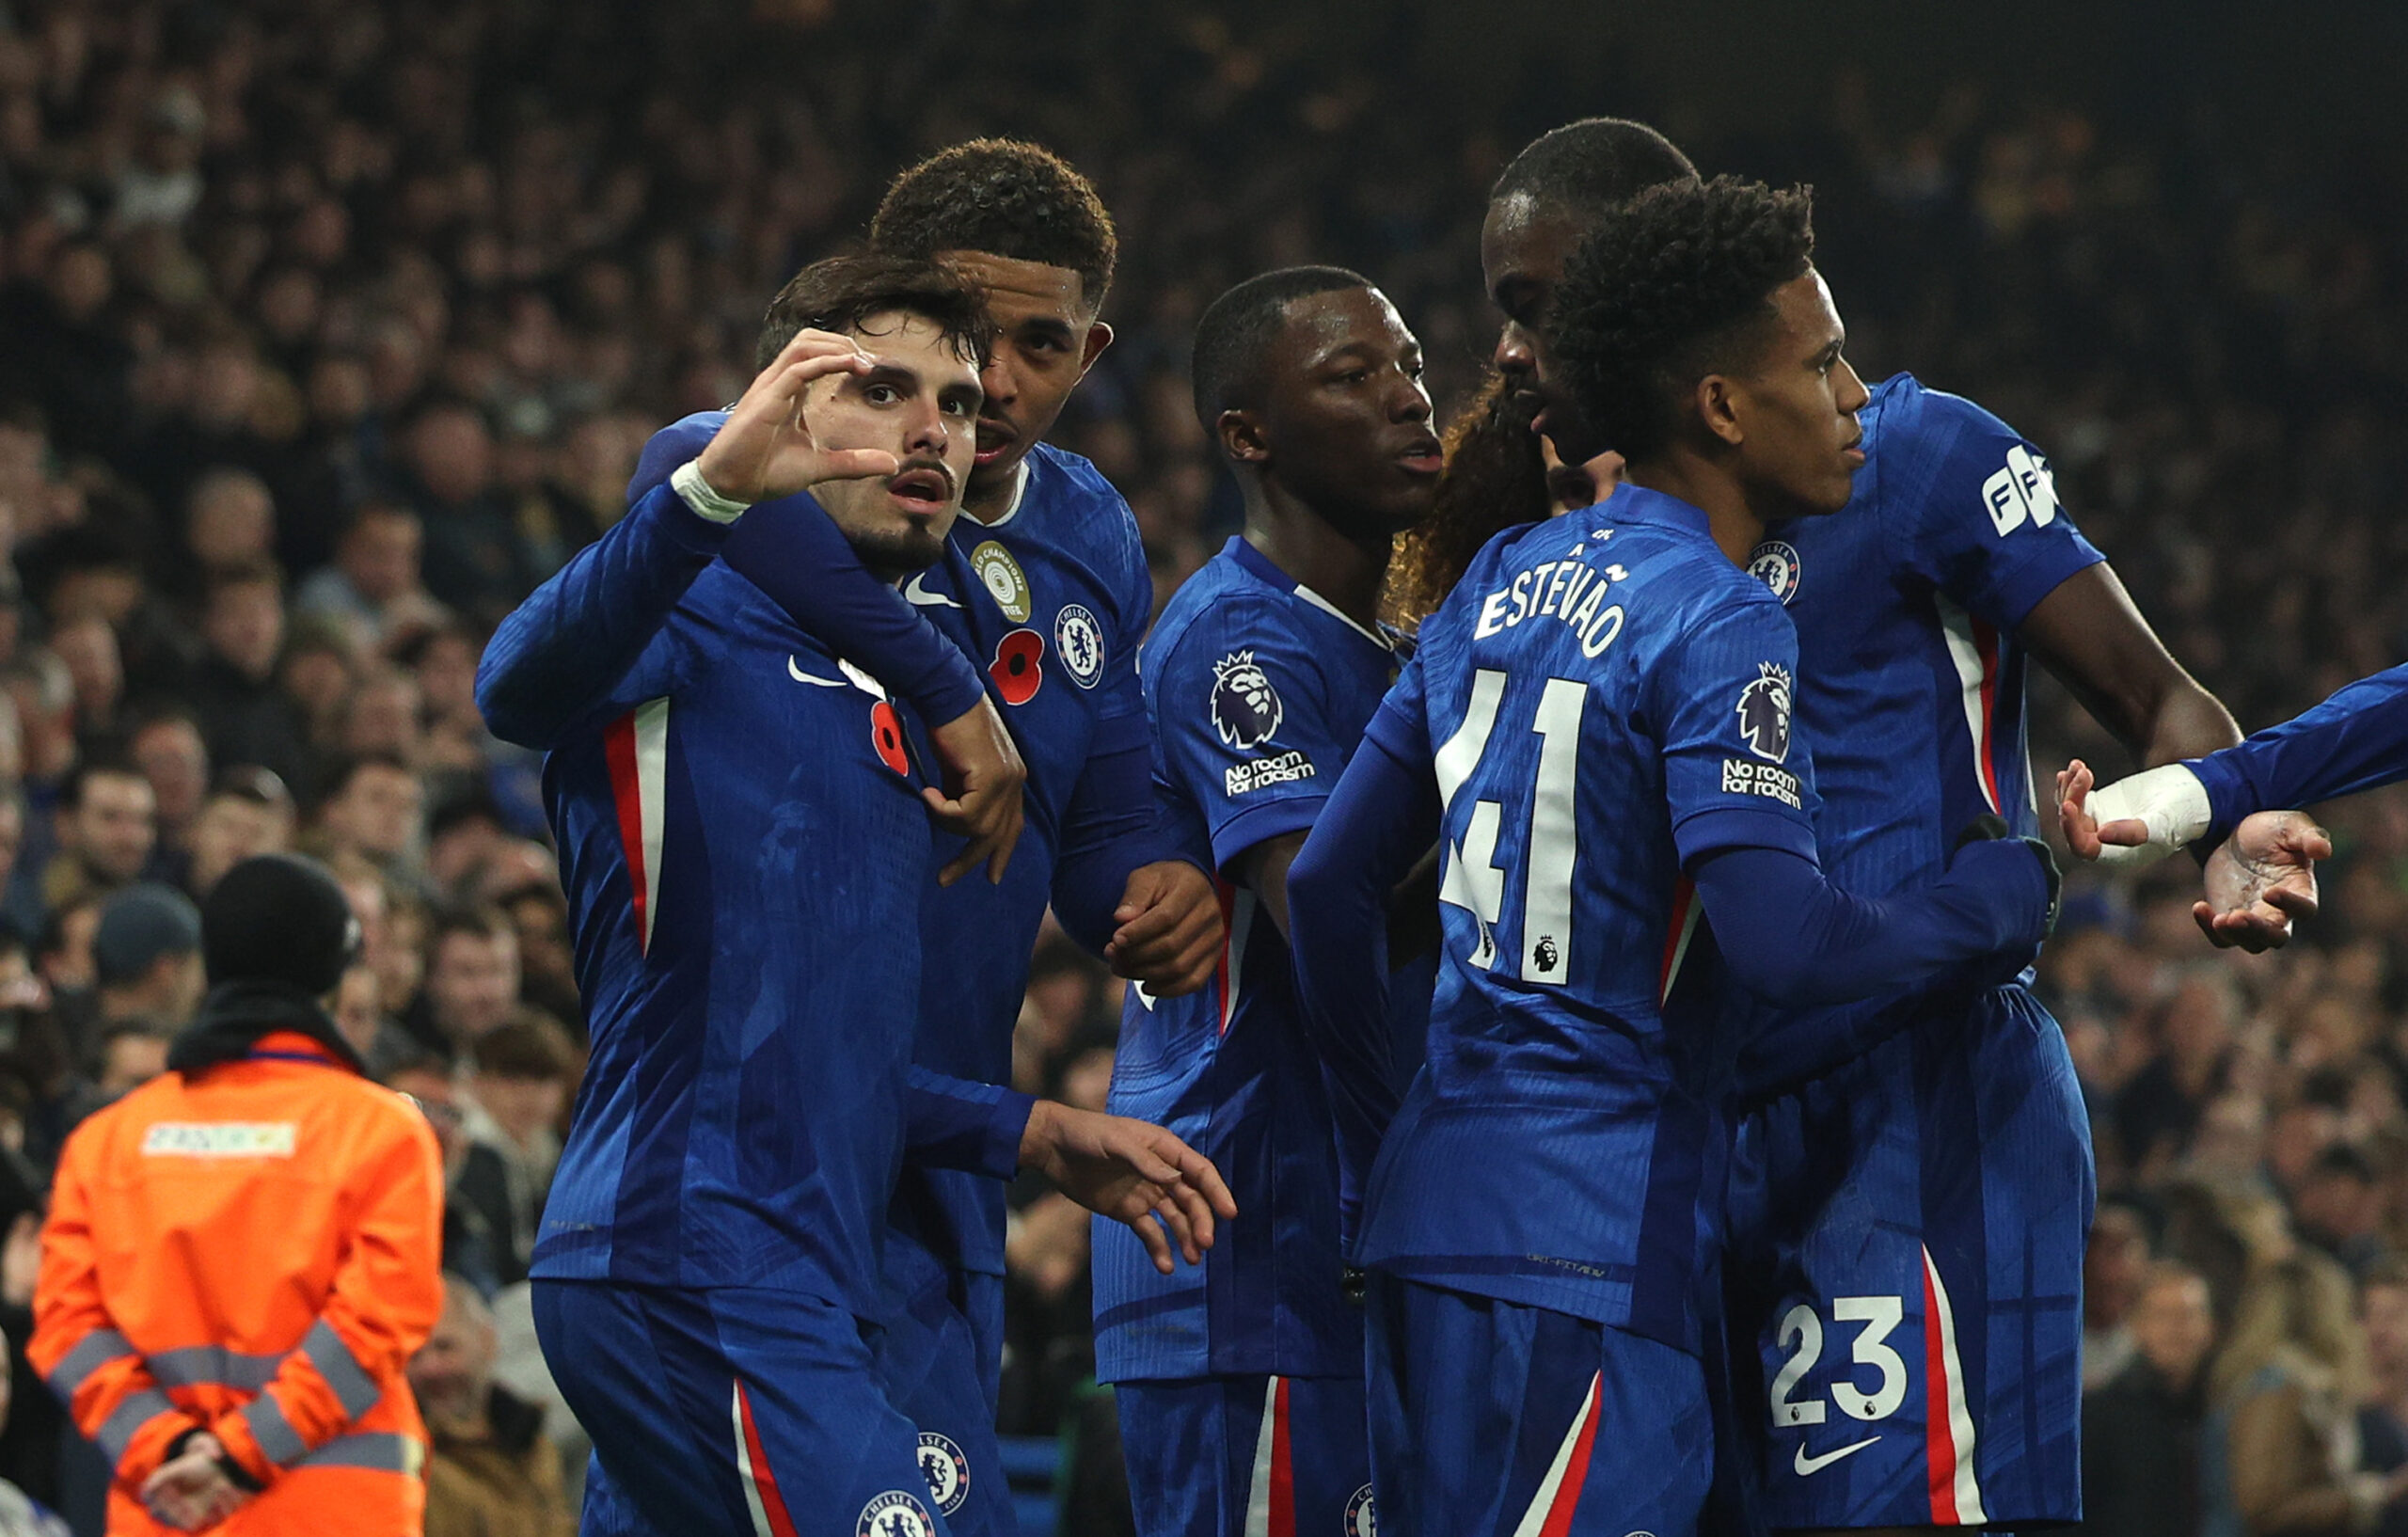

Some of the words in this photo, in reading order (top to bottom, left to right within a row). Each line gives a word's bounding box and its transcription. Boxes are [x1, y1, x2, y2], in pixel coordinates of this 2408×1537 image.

[983, 547, 1024, 592] CHAMPIONS
[1060, 608, 1091, 626] CHELSEA
[1473, 543, 1630, 658] ESTÊVÃO
[1226, 765, 1251, 783] No
[1251, 751, 1303, 774] room
[1227, 779, 1252, 798] for
[1254, 763, 1315, 789] racism
[1722, 759, 1753, 778] No
[1756, 765, 1797, 792] room
[1721, 775, 1752, 793] for
[1753, 781, 1801, 810] racism
[1434, 669, 1588, 985] 41
[1770, 1296, 1908, 1428] 23
[918, 1435, 948, 1450] LSEA
[864, 1495, 912, 1522] CHELSEA
